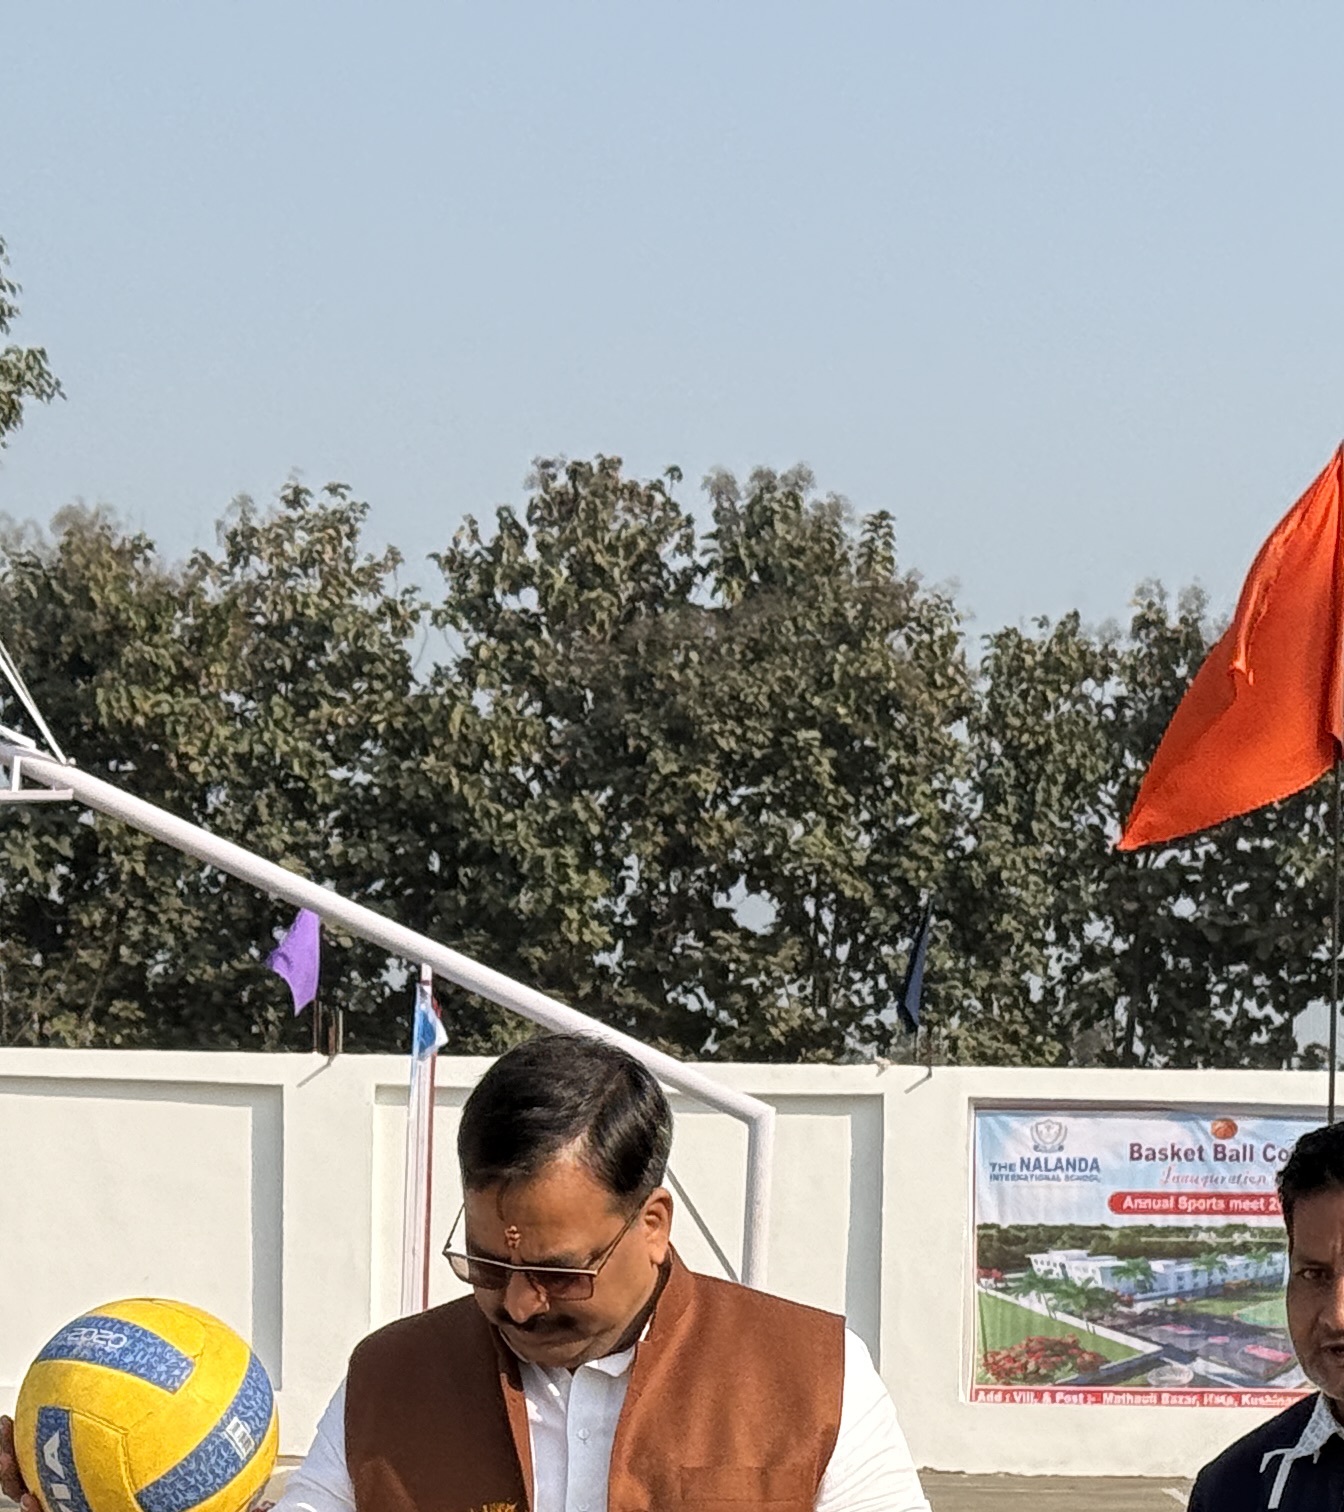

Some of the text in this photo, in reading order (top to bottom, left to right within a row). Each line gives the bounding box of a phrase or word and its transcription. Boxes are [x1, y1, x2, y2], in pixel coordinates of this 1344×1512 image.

[1129, 1142, 1290, 1162] Basket Ball Co
[989, 1156, 1101, 1173] THE NALANDA
[989, 1173, 1101, 1183] INTERNATIONAL SCHOOL
[1160, 1165, 1267, 1188] Inauguration
[1122, 1195, 1174, 1211] Annual
[1177, 1195, 1226, 1213] Sports
[1229, 1196, 1266, 1212] meet
[66, 1326, 128, 1350] 2020
[976, 1391, 1002, 1404] Add
[1056, 1392, 1084, 1405] Post
